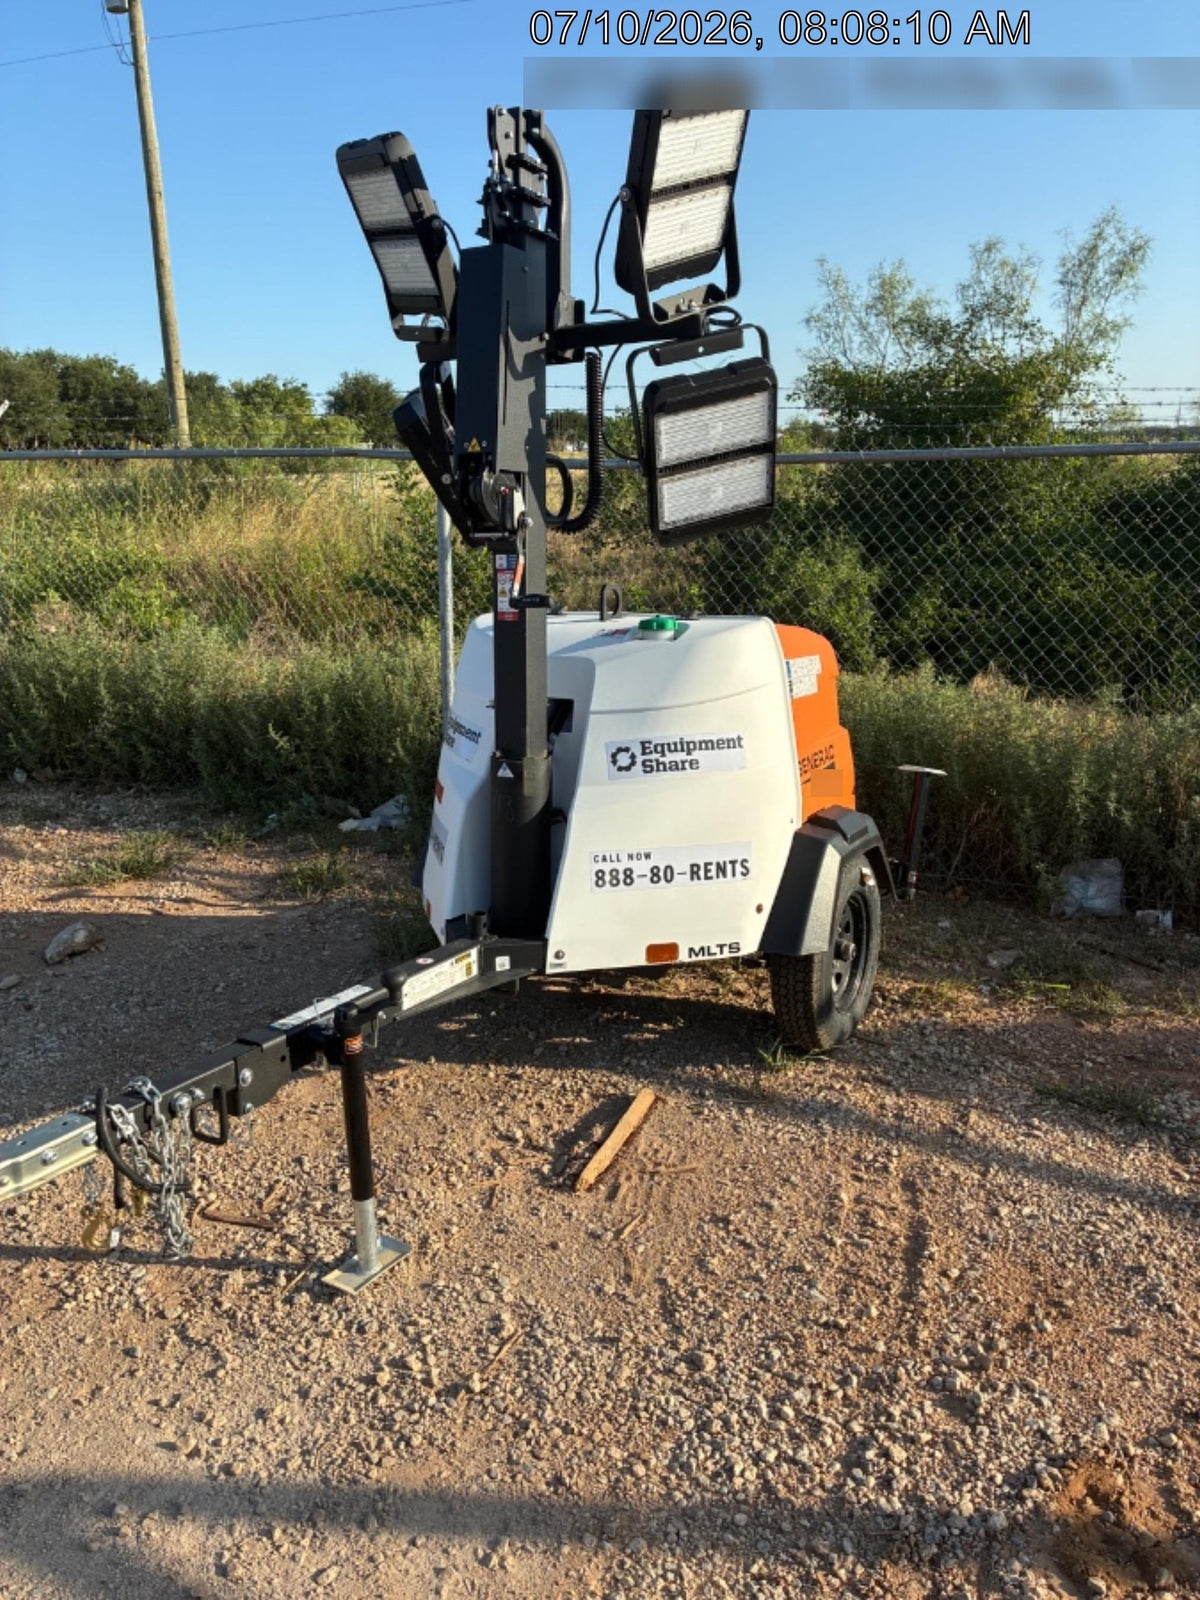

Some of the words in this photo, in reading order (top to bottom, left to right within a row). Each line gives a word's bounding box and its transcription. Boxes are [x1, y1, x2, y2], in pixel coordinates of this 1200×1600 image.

[640, 734, 744, 757] Equipment
[641, 758, 700, 774] Share
[593, 852, 622, 864] CALL
[627, 851, 652, 862] NOW
[594, 858, 750, 888] 888-80-RENTS
[688, 942, 741, 959] MLTS
